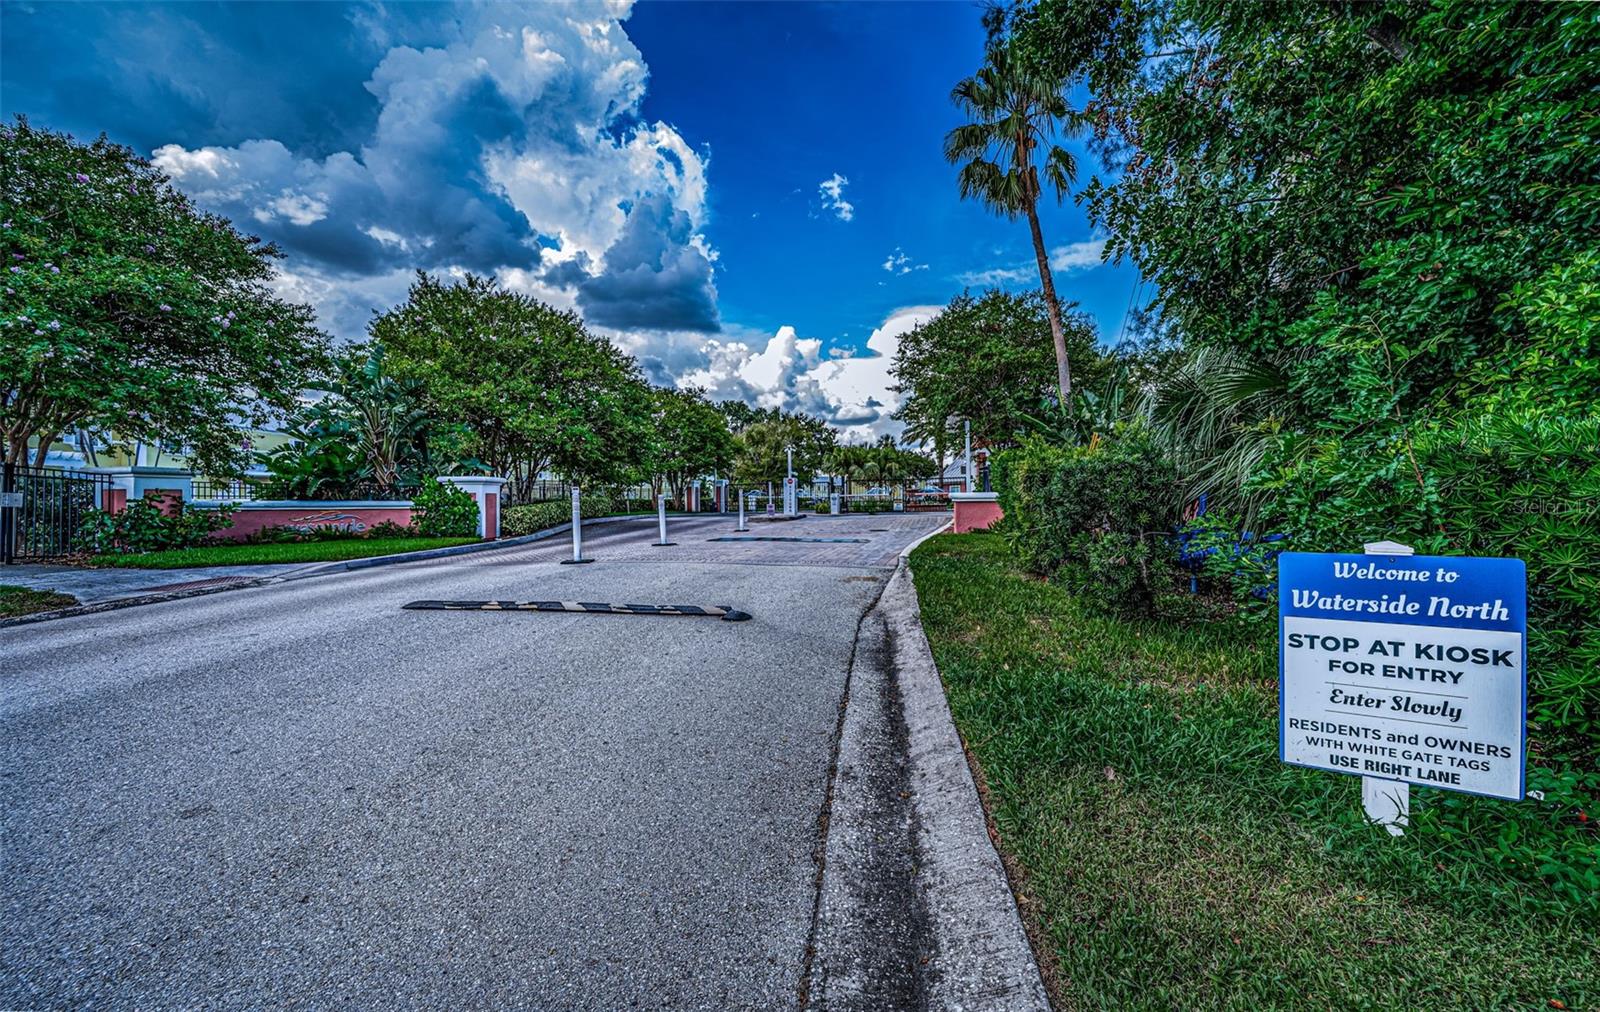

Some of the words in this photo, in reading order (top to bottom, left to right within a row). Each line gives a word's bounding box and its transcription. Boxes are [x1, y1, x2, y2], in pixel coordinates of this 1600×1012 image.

[1333, 561, 1431, 581] Welcome
[1436, 568, 1460, 583] to
[1291, 589, 1420, 615] Waterside
[1427, 596, 1510, 621] North
[1288, 633, 1360, 653] STOP
[1368, 640, 1405, 657] AT
[1415, 643, 1514, 667] KIOSK
[1328, 659, 1375, 676] FOR
[1382, 664, 1464, 684] ENTRY
[1329, 688, 1386, 709] Enter
[1390, 695, 1462, 722] Slowly
[1289, 718, 1381, 740] RESIDENTS
[1386, 733, 1419, 746] and
[1424, 736, 1512, 759] OWNERS
[1306, 736, 1343, 750] WITH
[1347, 742, 1397, 758] WHITE
[1401, 750, 1443, 765] GATE
[1447, 756, 1491, 772] TAGS
[1329, 754, 1359, 769] USE
[1364, 760, 1412, 777] RIGHT
[1417, 767, 1461, 785] LANE
